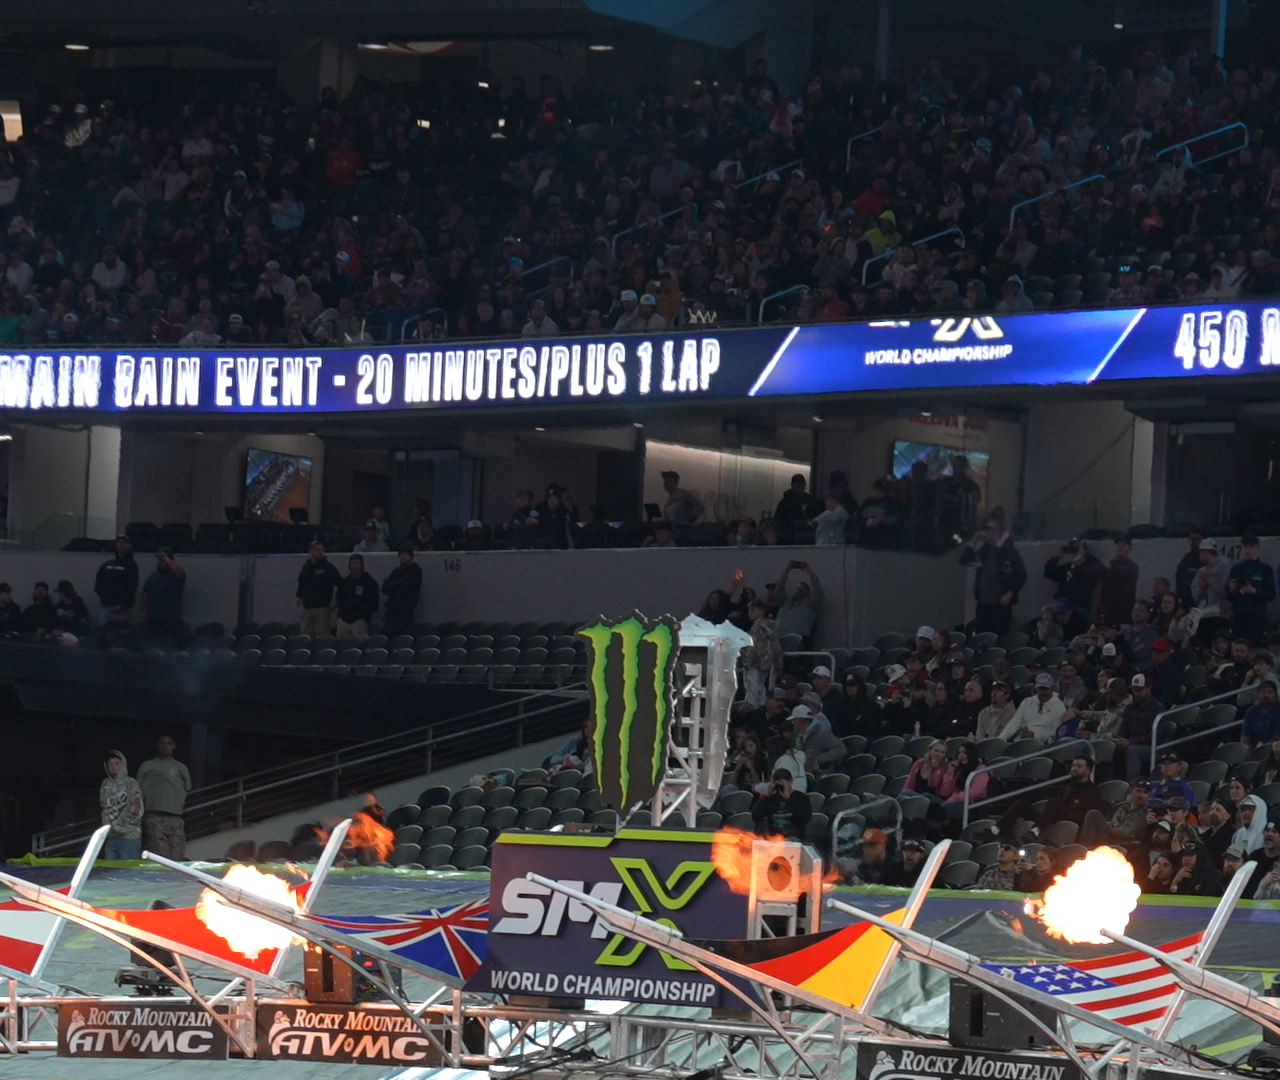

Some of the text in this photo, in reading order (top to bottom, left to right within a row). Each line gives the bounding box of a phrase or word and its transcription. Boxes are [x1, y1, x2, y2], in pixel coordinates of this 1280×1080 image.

[1174, 309, 1245, 369] 450
[865, 343, 1012, 365] WORLD CHAMPIONSHIP
[216, 357, 321, 407] EVENT
[356, 355, 391, 404] 20
[404, 343, 626, 403] MINUTES/PLUS
[637, 341, 651, 394] 1
[661, 338, 720, 392] LAP
[443, 559, 461, 573] 146
[492, 857, 717, 971] SMX
[490, 969, 717, 1003] WORLD CHAMPIONSHIP
[88, 1007, 214, 1028] ROCKY MOUNTAIN
[293, 1009, 431, 1034] ROCKY MOUNTAIN
[898, 1049, 960, 1076] ROCKY
